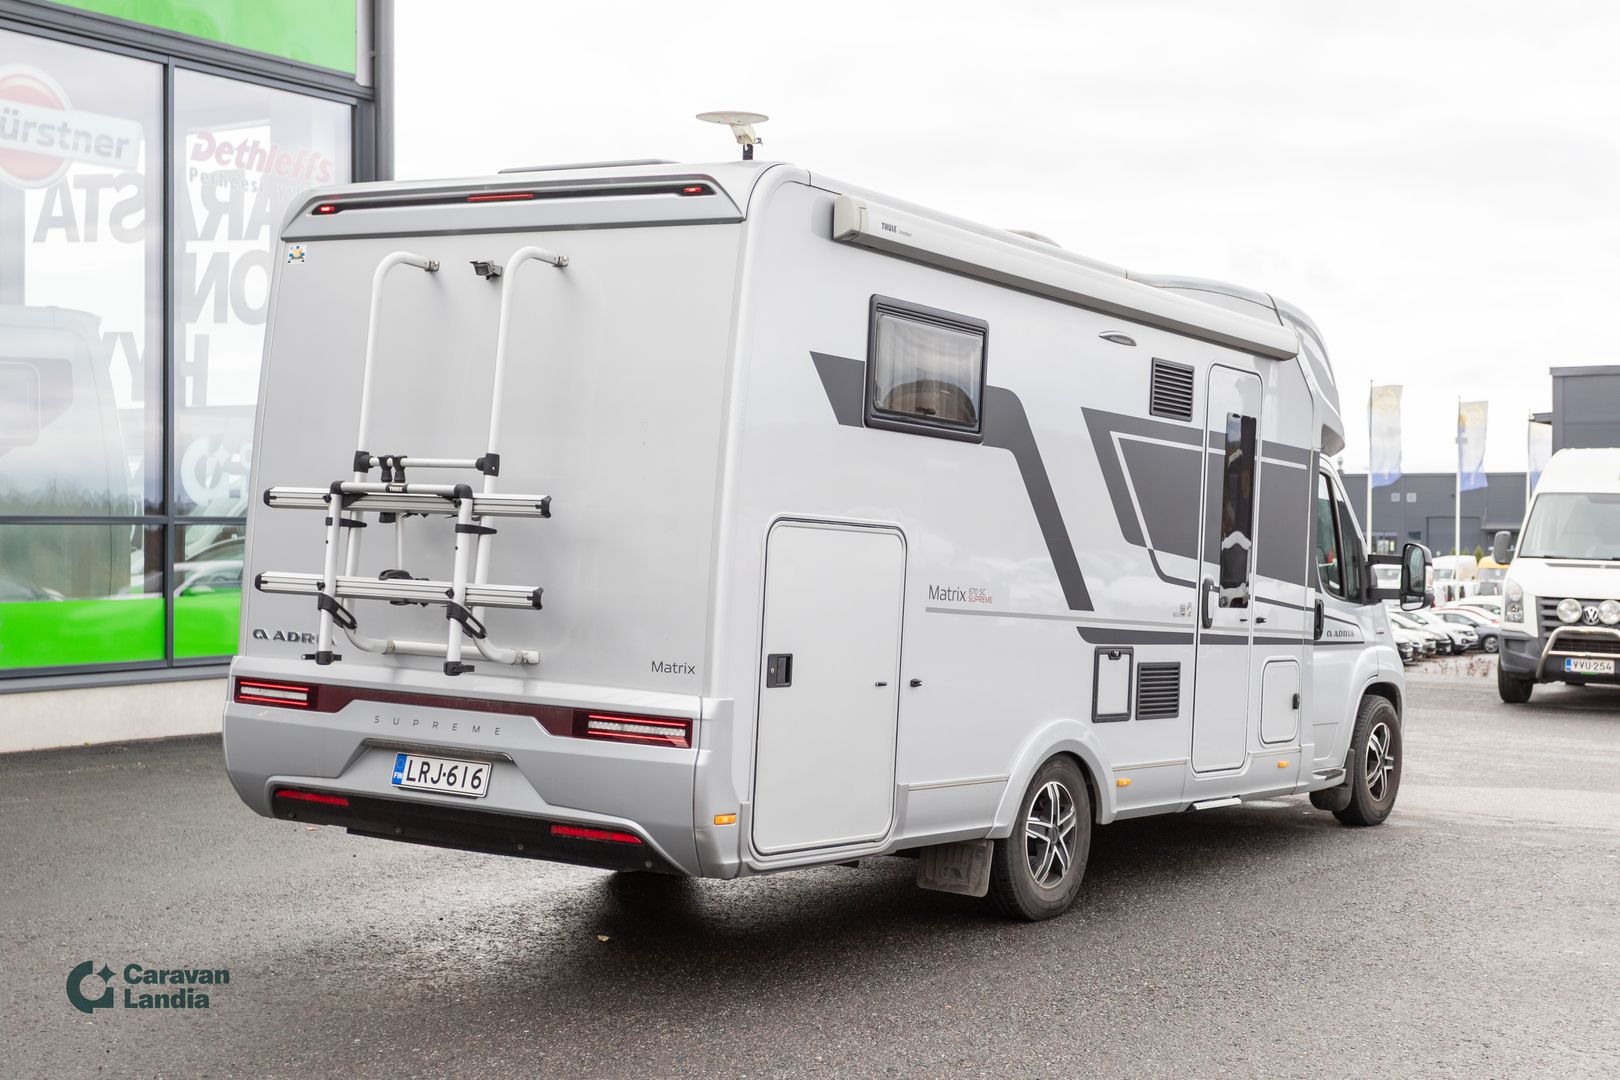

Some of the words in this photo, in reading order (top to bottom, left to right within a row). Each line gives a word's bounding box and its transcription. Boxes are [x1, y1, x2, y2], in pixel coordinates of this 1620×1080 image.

[0, 107, 130, 159] ürstner
[189, 130, 333, 184] Dethleffs
[928, 584, 967, 602] Matrix
[968, 595, 993, 603] SUPREME
[651, 660, 696, 675] Matrix
[373, 715, 501, 736] SUPREME
[406, 759, 483, 790] LRJ-616
